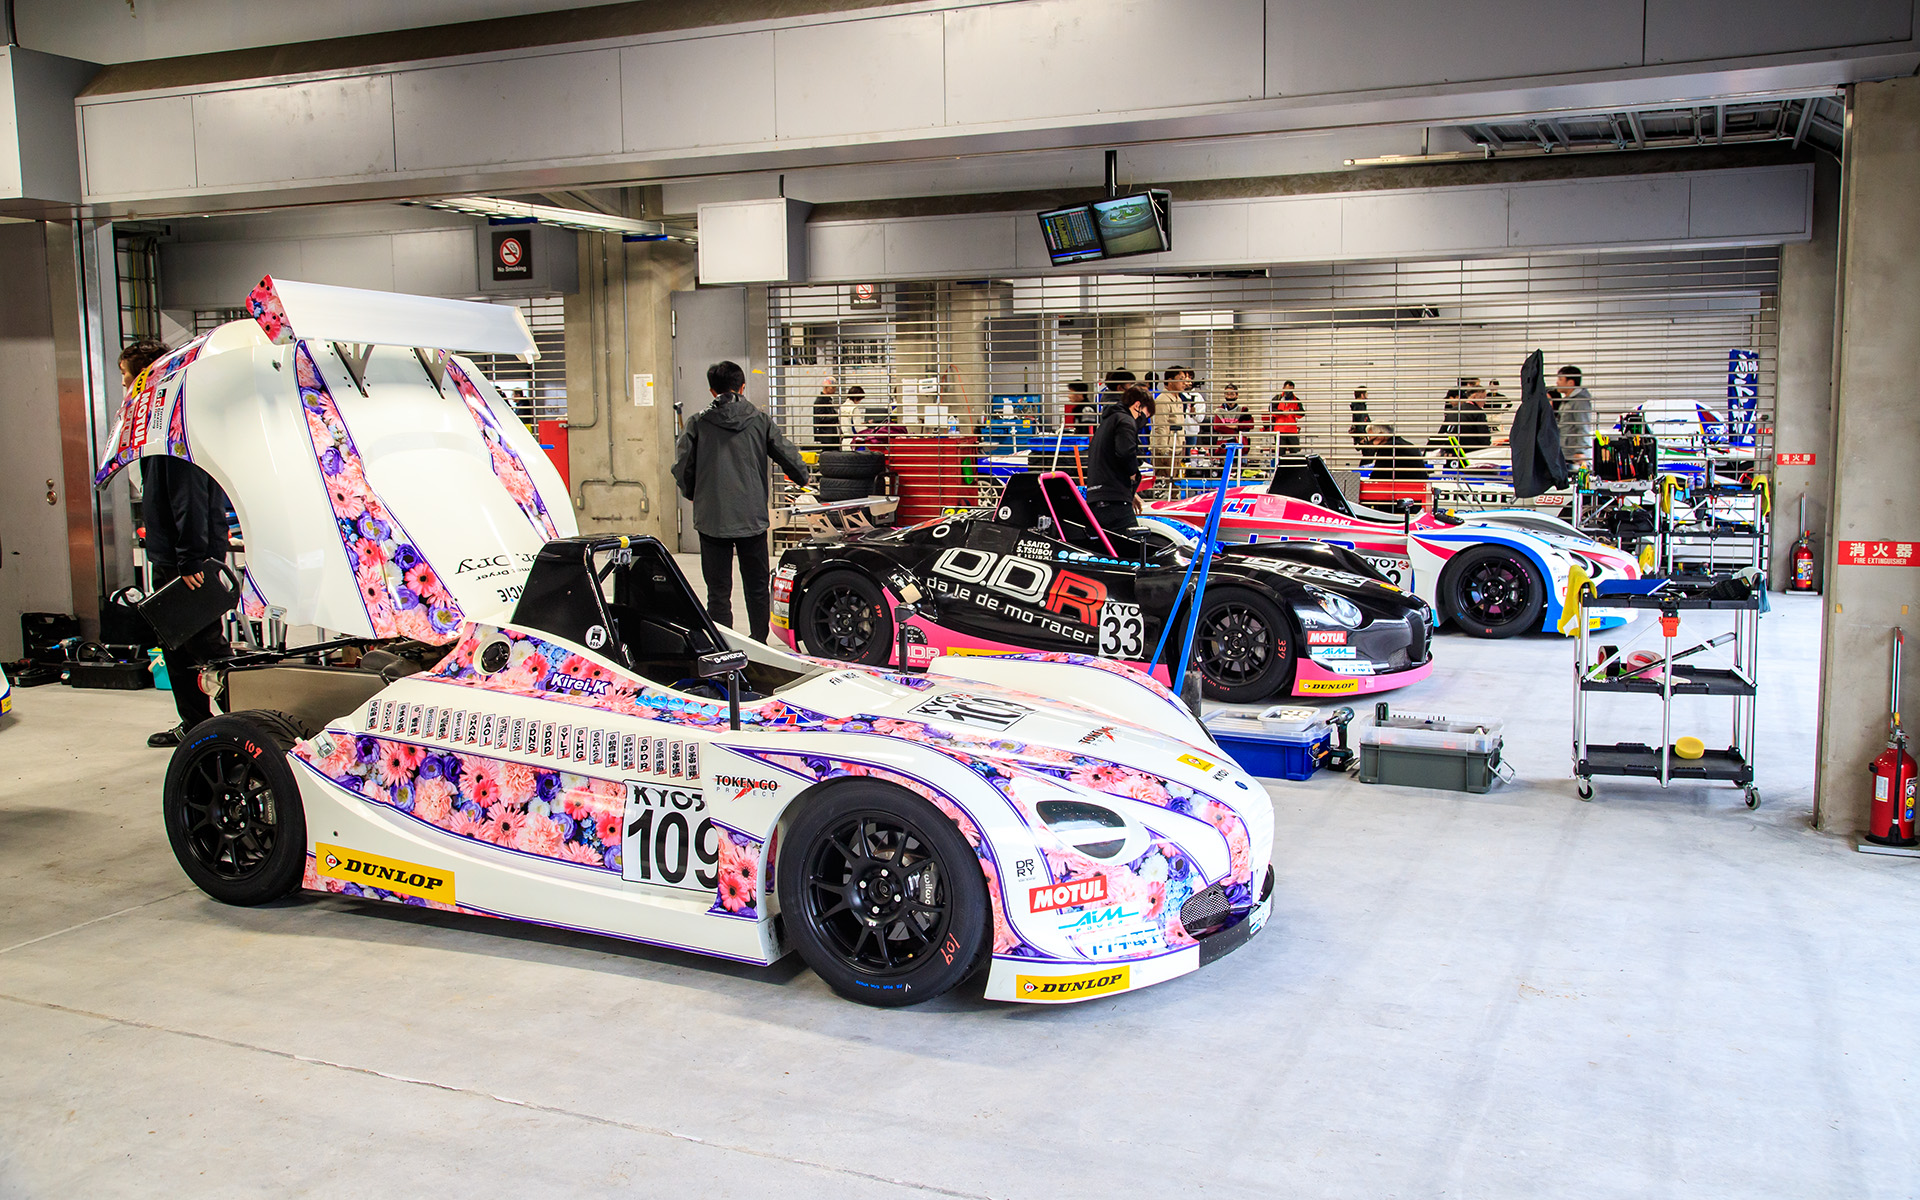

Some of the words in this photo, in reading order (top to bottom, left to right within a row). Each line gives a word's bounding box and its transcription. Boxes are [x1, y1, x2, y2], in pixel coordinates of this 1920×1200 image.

[134, 391, 151, 447] MOTUL
[1782, 454, 1811, 462] 消火器
[1302, 514, 1351, 526] R.SASAKI
[1016, 545, 1053, 557] S.TSUBOI
[1018, 539, 1051, 550] A.SAITO
[1849, 542, 1913, 558] 消火器
[455, 554, 511, 575] Dry
[1867, 557, 1907, 565] EXTINGUISHER
[926, 576, 949, 593] da
[975, 593, 999, 611] de
[1003, 604, 1036, 623] mo
[1040, 615, 1095, 645] racer
[1101, 616, 1143, 655] 33
[1309, 632, 1345, 643] MOTUL
[550, 673, 609, 695] Kirei.K
[1312, 682, 1355, 690] DUNLOP
[244, 739, 264, 759] 109
[527, 728, 537, 752] DNS
[543, 731, 552, 755] DRP
[559, 732, 569, 757] YLT
[575, 735, 584, 759] LHG
[715, 774, 757, 790] TOKEN
[758, 779, 779, 792] GO
[628, 808, 720, 890] 109
[344, 858, 444, 891] DUNLOP
[1033, 879, 1105, 910] MOTUL
[940, 932, 961, 966] 109
[1041, 973, 1123, 994] DUNLOP
